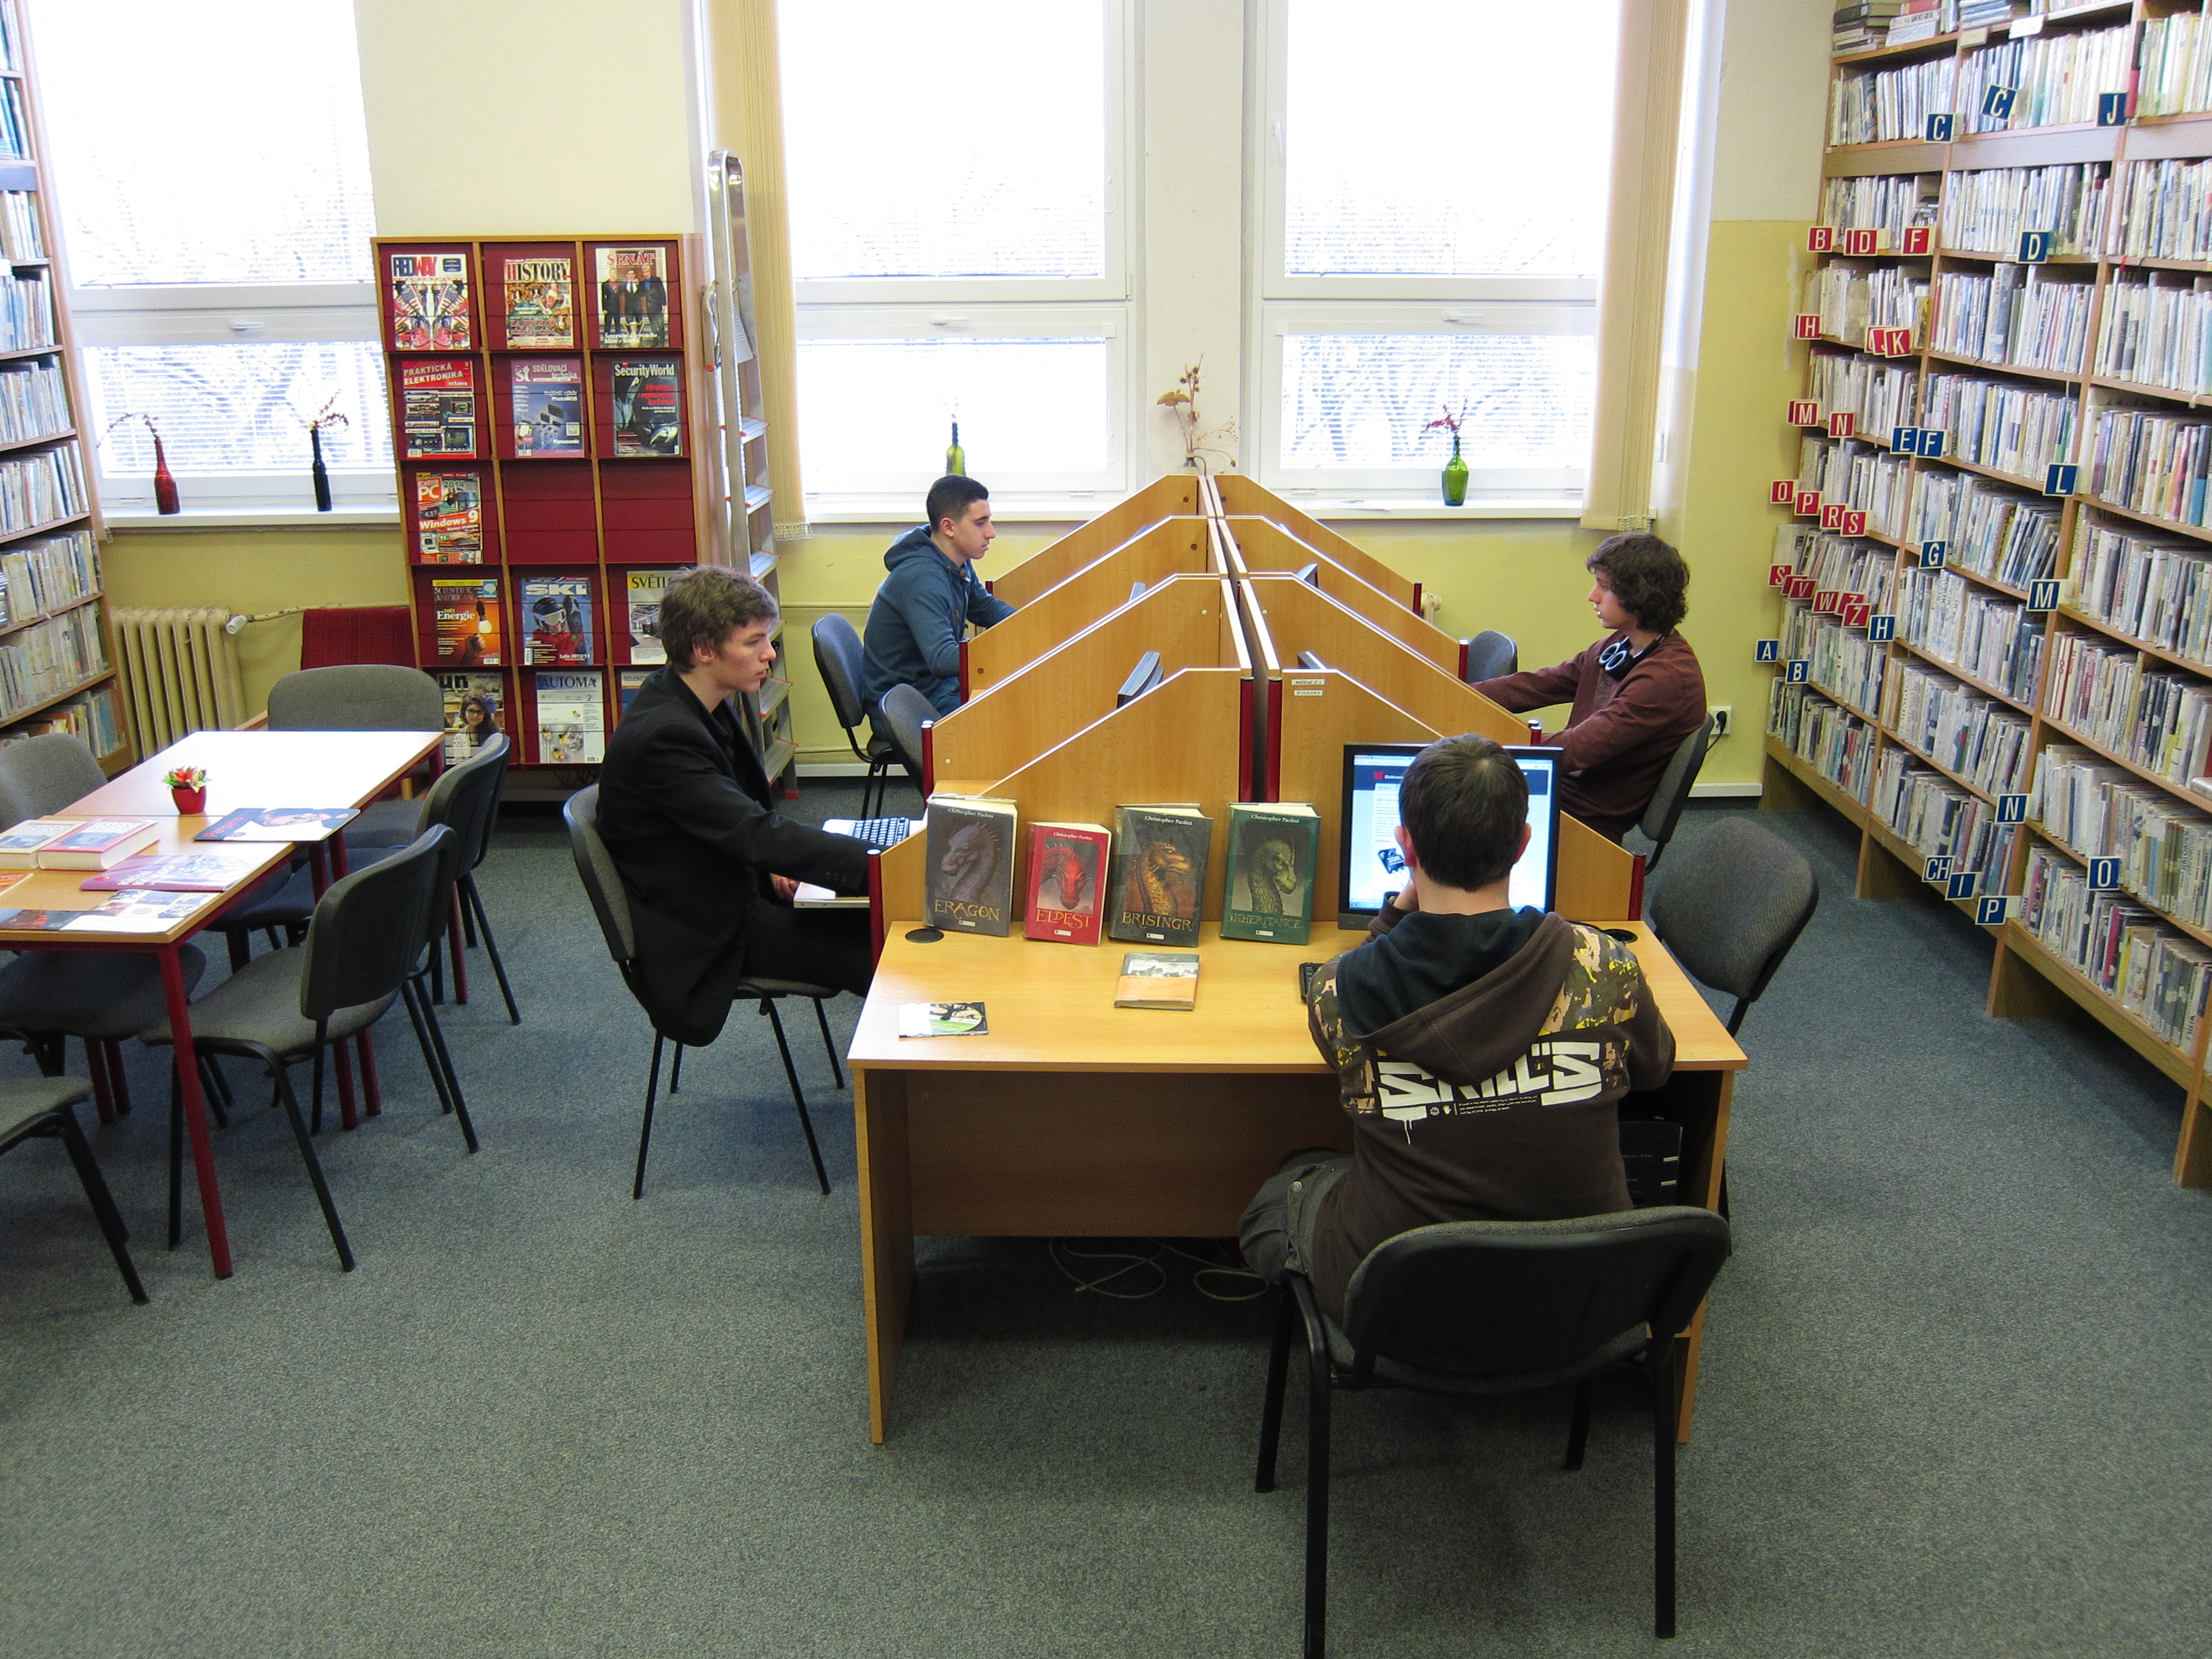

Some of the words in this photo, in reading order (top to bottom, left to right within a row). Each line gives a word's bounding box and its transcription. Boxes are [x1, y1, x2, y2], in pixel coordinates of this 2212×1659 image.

[1990, 89, 2007, 116] Č
[2106, 95, 2118, 125] J
[1933, 116, 1945, 140] C
[1815, 229, 1826, 250] B
[1858, 232, 1871, 253] D
[1909, 230, 1922, 252] F
[2027, 234, 2041, 260] D
[607, 250, 654, 265] SENÁT
[506, 263, 569, 281] HISTORY
[1805, 317, 1815, 337] H
[1892, 331, 1905, 354] K
[403, 362, 453, 376] PRAKTICKÁ
[404, 370, 463, 385] ELEKTRONIKA
[614, 364, 675, 378] SecurityWorld
[1798, 404, 1812, 424] M
[1835, 415, 1848, 435] N
[1900, 429, 1912, 451] E
[1924, 432, 1938, 455] F
[443, 480, 465, 488] 2014
[2056, 466, 2067, 493] L
[418, 486, 440, 501] PC
[1778, 482, 1788, 501] O
[1802, 494, 1813, 513] P
[420, 517, 467, 529] Windows
[468, 510, 478, 523] 9
[1828, 506, 1839, 526] R
[1849, 514, 1859, 534] S
[1928, 543, 1940, 566] G
[1775, 566, 1786, 585] Š
[526, 584, 588, 595] SKI
[1799, 582, 1809, 598] V
[2034, 583, 2054, 608] M
[1819, 593, 1835, 611] W
[437, 610, 475, 622] Energie
[1875, 618, 1889, 639] H
[1761, 642, 1772, 660] A
[543, 676, 597, 688] AUTOMA
[1793, 663, 1803, 681] B
[948, 808, 977, 816] Christopher
[2005, 797, 2020, 820] N
[1926, 859, 1951, 880] CH
[2098, 860, 2111, 887] O
[1958, 875, 1965, 897] I
[934, 899, 1000, 921] ERAGON
[1036, 909, 1093, 929] ELDEST
[1985, 899, 2000, 922] P
[1122, 911, 1192, 931] BRISINGR
[1230, 913, 1302, 928] INHERITANCE
